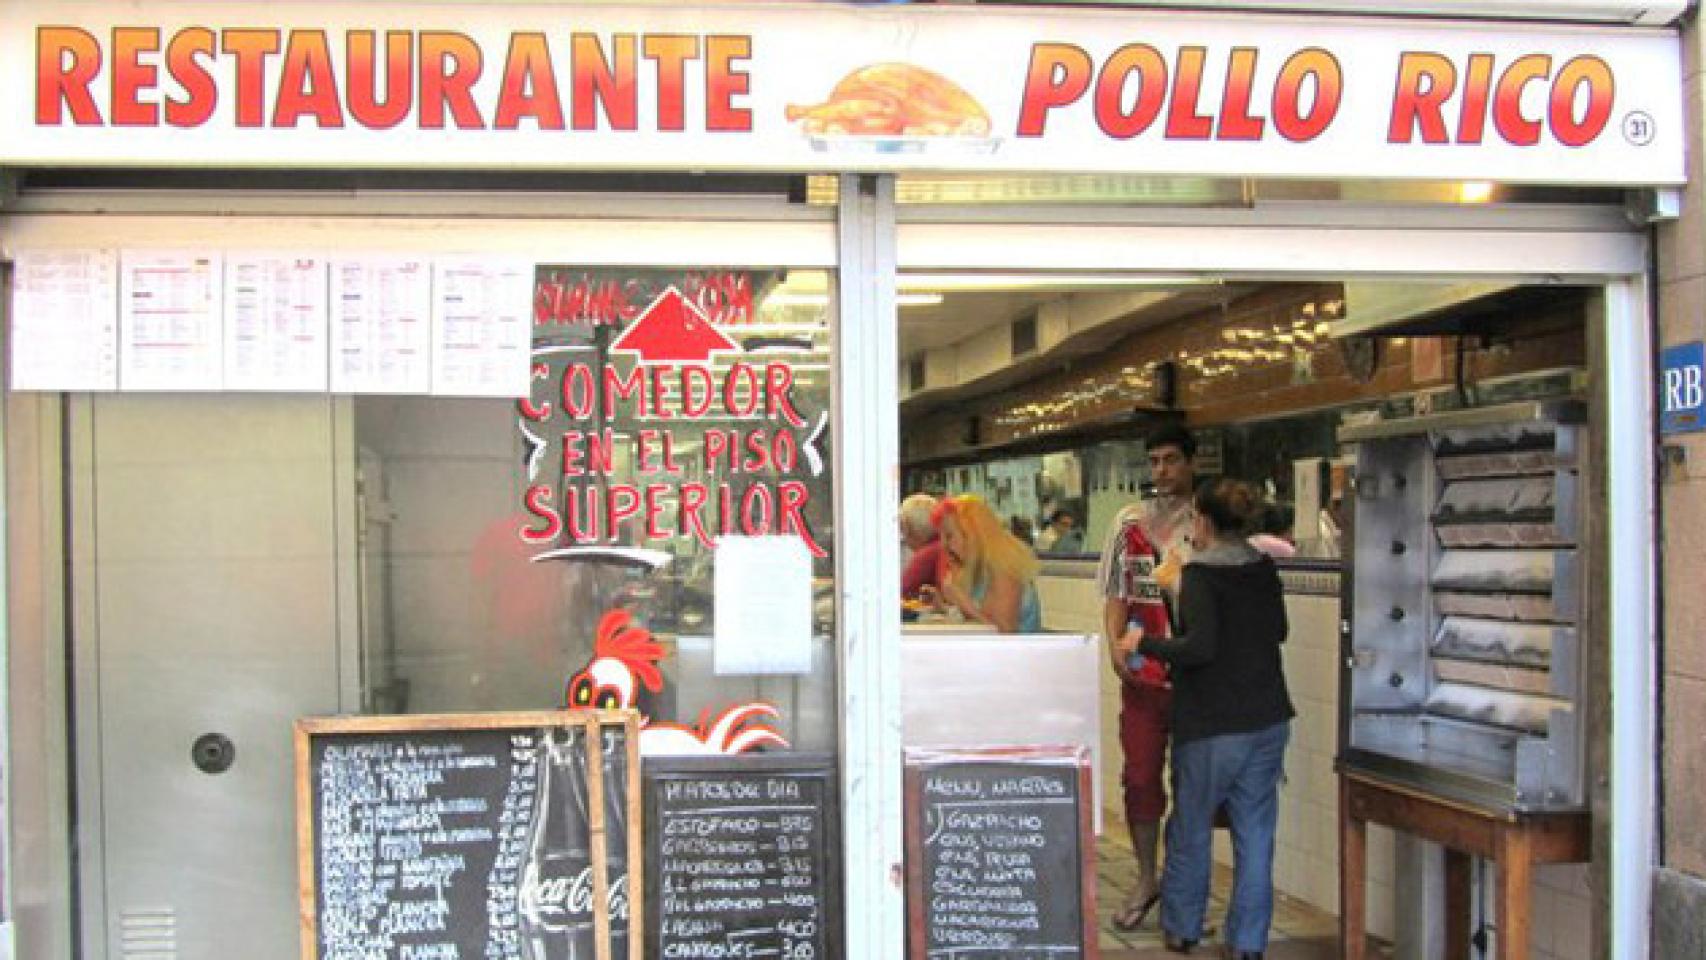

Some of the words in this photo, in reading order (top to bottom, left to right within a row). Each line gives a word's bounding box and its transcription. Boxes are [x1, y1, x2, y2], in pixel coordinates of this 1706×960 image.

[34, 25, 754, 131] RESTAURANTE
[1016, 42, 1344, 143] POLLO
[1387, 51, 1615, 147] RICO
[1630, 119, 1648, 137] 31
[517, 362, 808, 427] COMEDOR
[1664, 365, 1703, 411] RB
[562, 427, 614, 477] EN
[637, 429, 680, 474] EL
[703, 428, 799, 474] PISO
[520, 481, 829, 557] SUPERIOR
